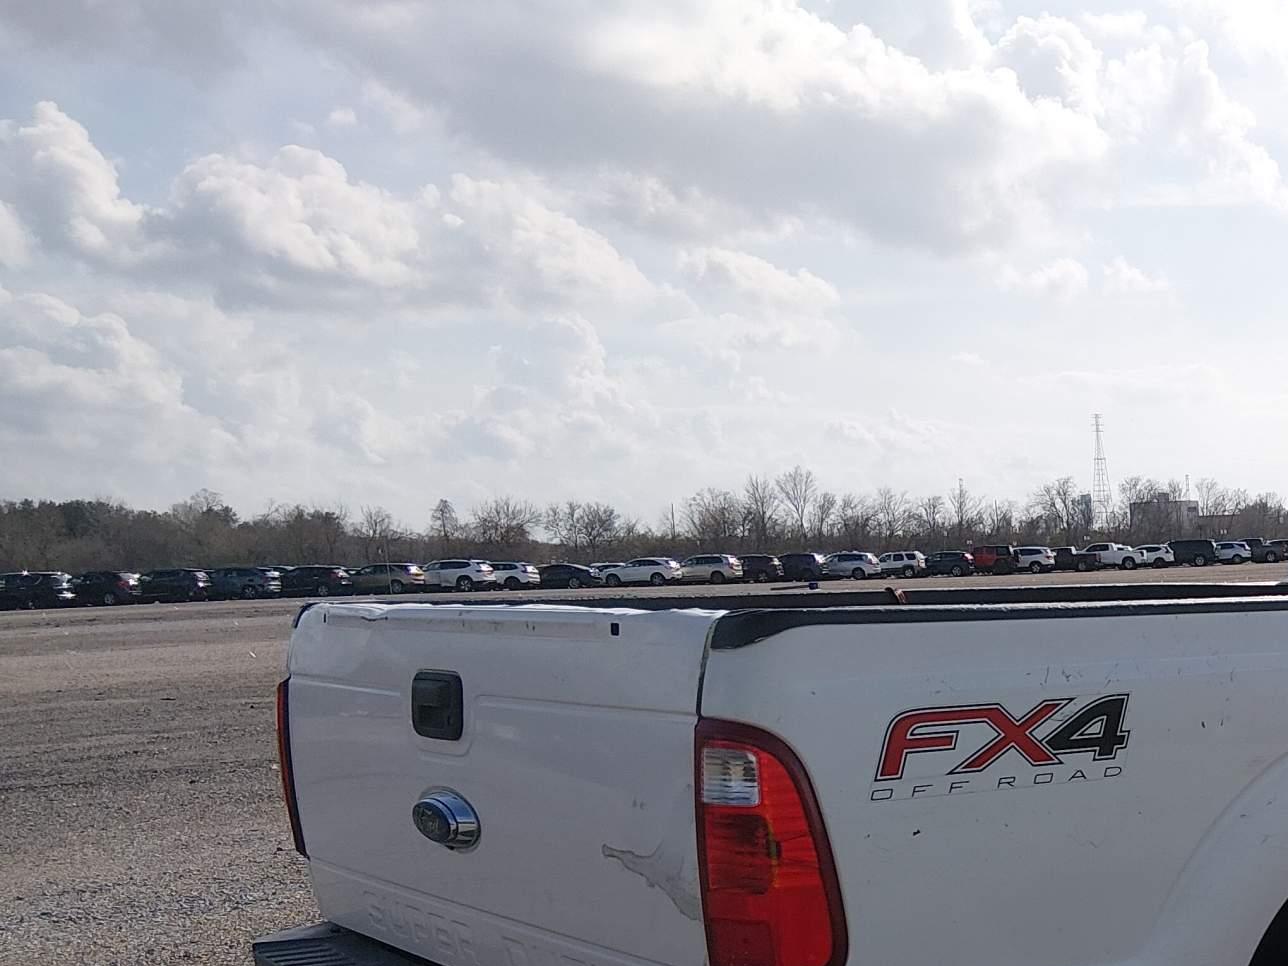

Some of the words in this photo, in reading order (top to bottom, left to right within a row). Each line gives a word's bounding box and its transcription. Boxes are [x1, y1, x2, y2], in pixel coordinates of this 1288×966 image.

[873, 692, 1131, 782] FX4
[870, 780, 970, 802] OFF
[996, 766, 1123, 790] ROAD
[363, 890, 481, 966] SUPER
